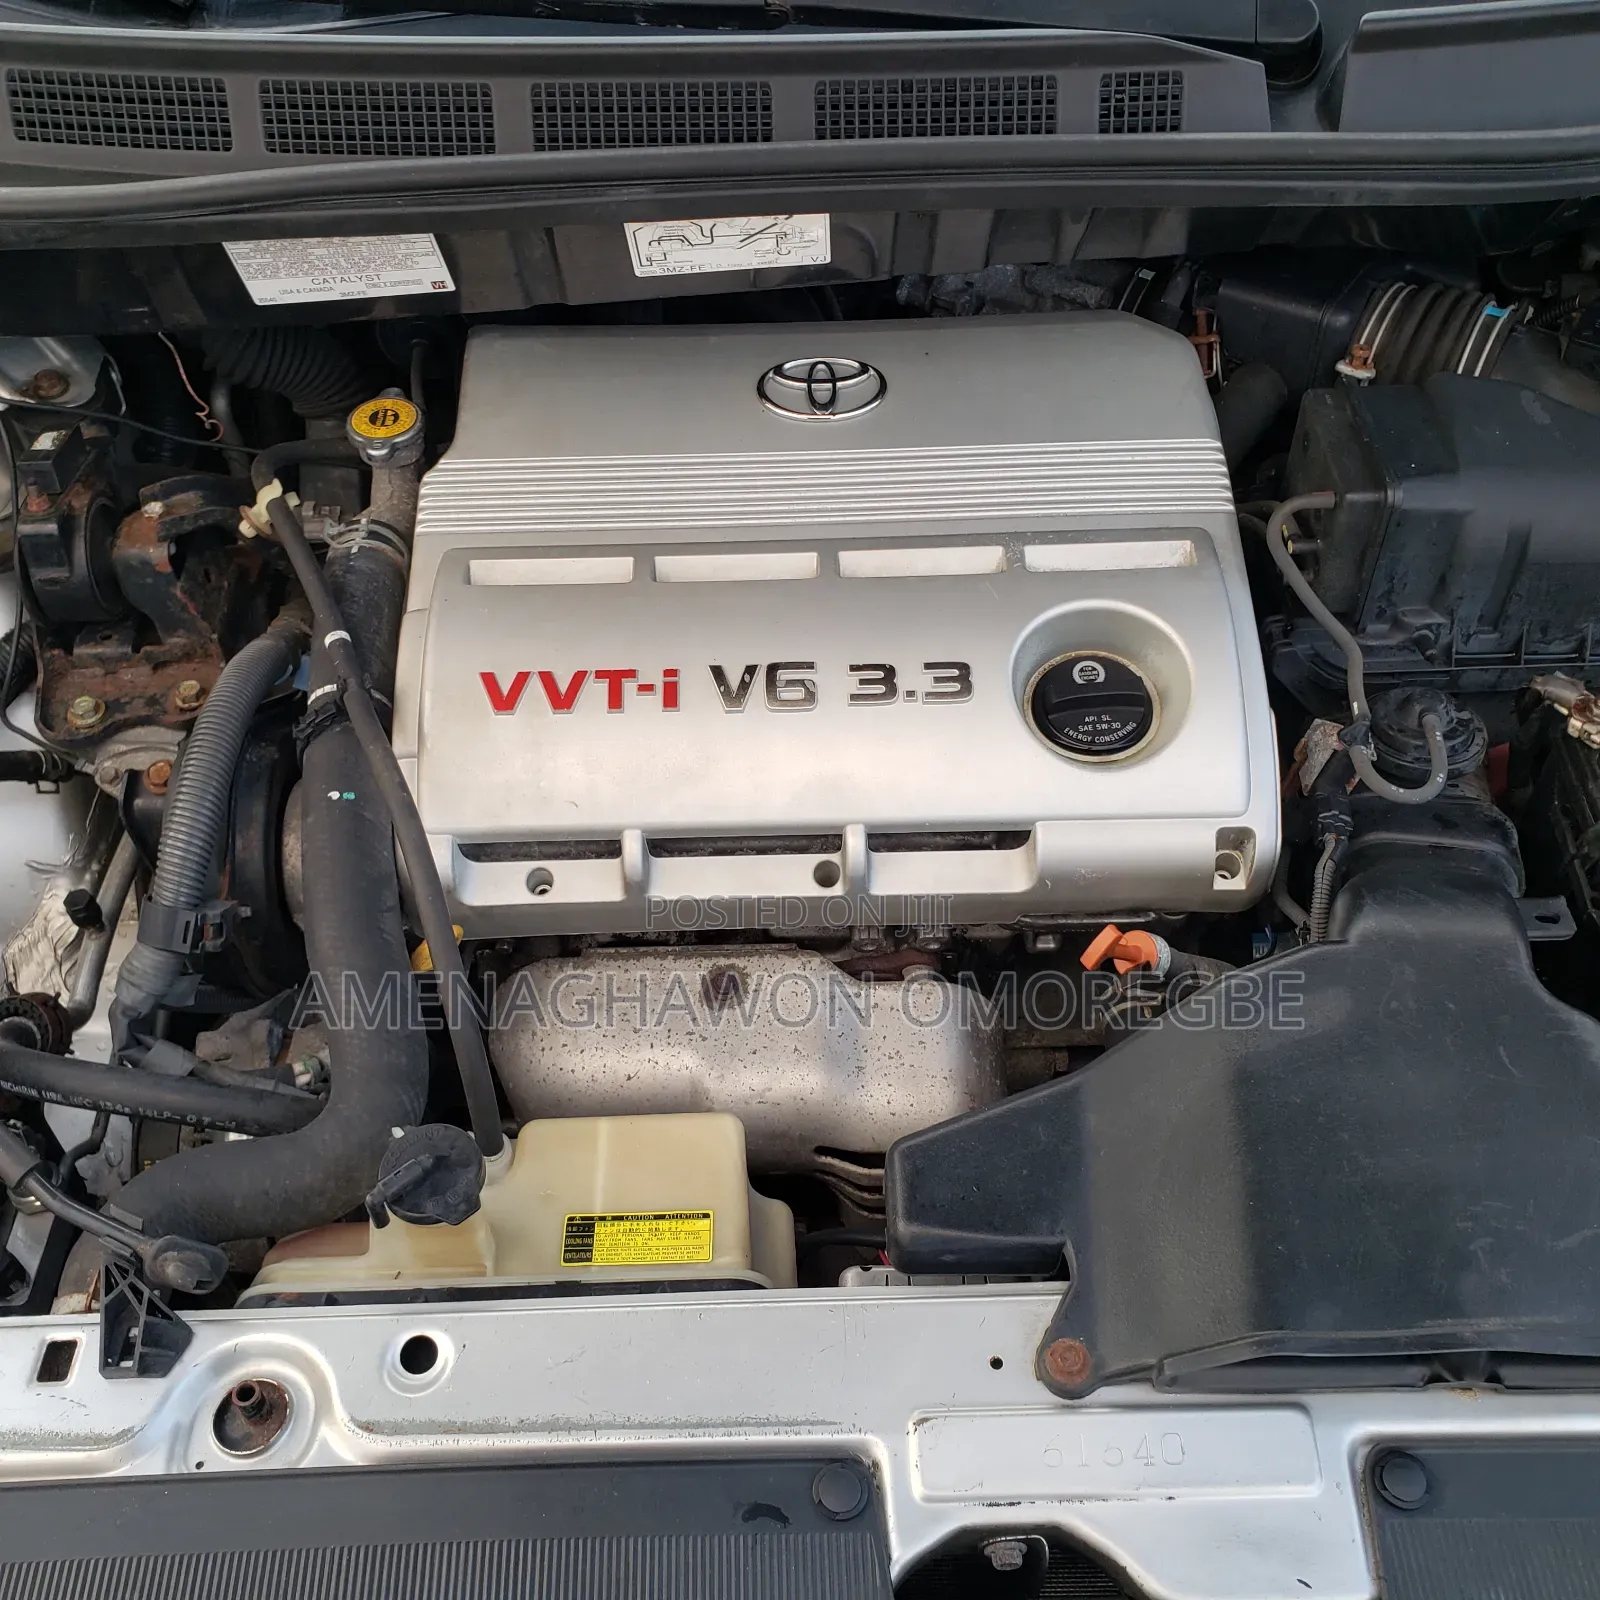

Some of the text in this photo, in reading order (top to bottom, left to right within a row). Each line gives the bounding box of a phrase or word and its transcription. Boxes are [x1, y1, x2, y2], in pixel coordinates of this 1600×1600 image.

[659, 264, 706, 275] 3MZ-FE
[311, 274, 382, 286] CATALYST
[432, 281, 448, 289] VH
[303, 286, 335, 294] CANADA
[478, 661, 975, 716] VVT-i V6 3.3
[1063, 721, 1137, 743] ENERGY CONSERVING
[1078, 722, 1121, 732] SAE 5W-30
[664, 1212, 704, 1220] ATTENTION
